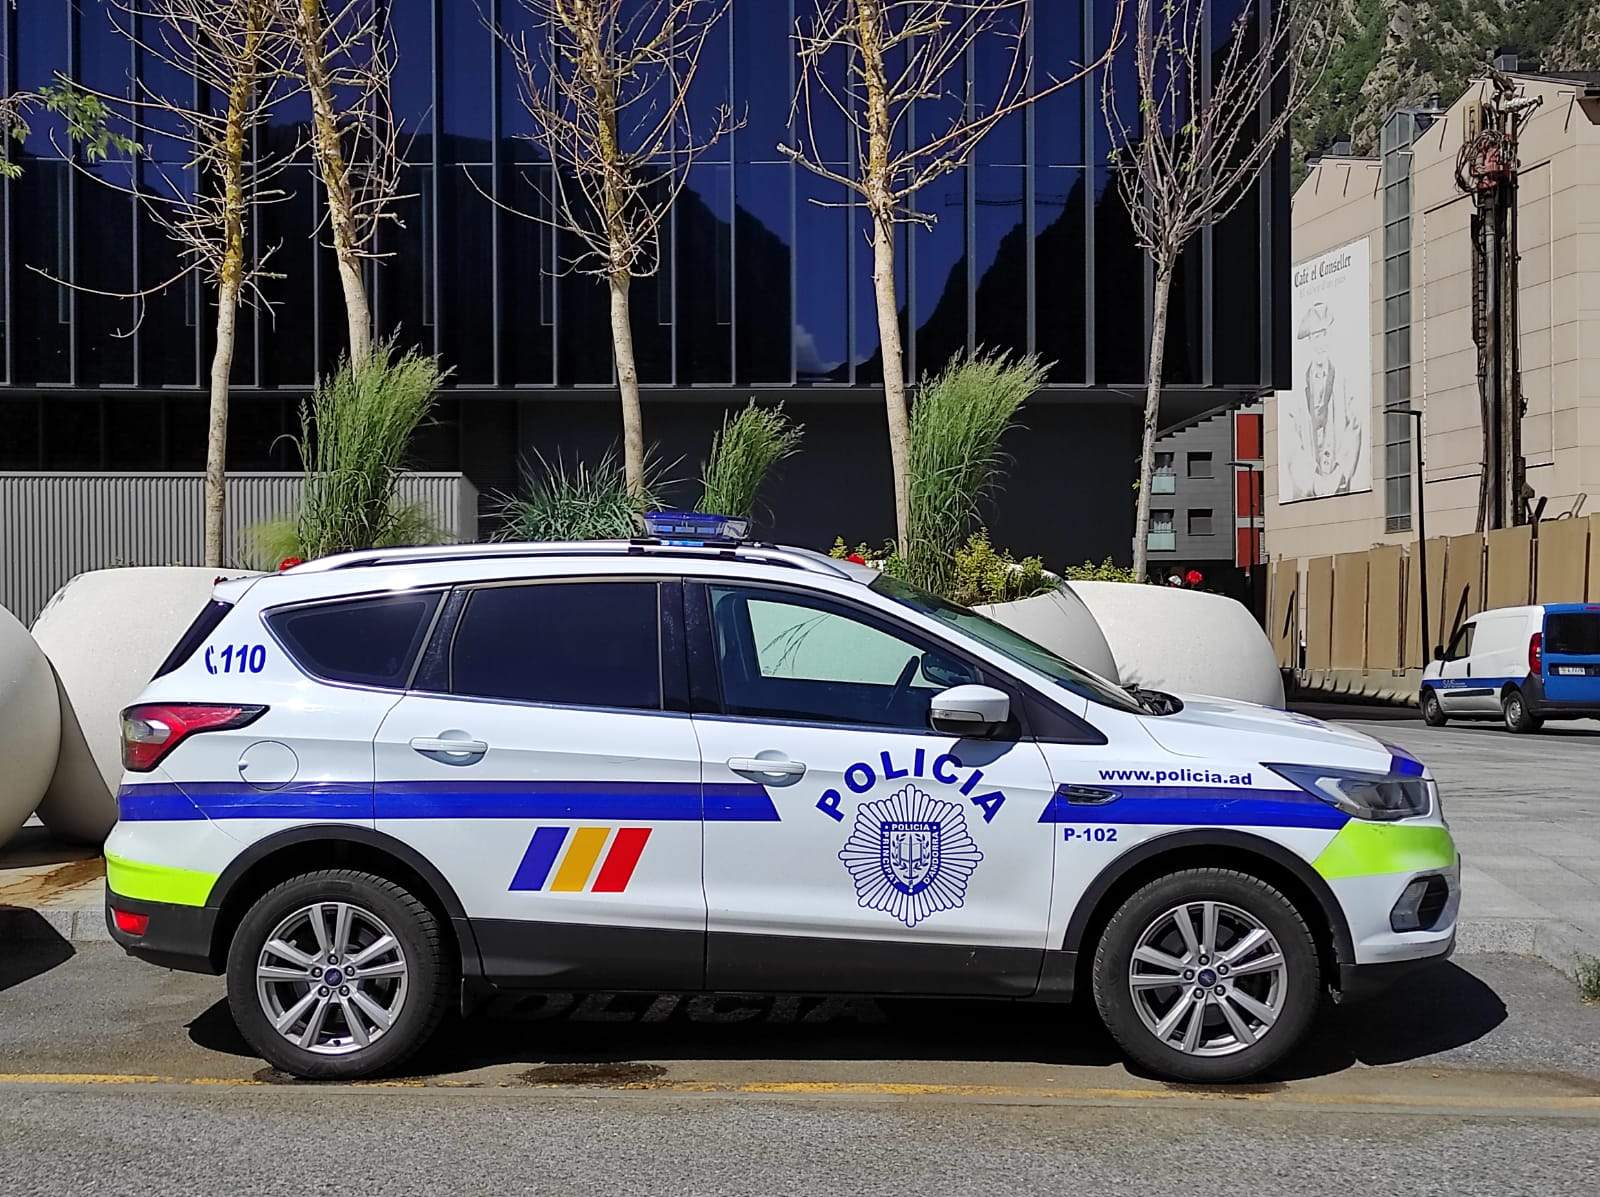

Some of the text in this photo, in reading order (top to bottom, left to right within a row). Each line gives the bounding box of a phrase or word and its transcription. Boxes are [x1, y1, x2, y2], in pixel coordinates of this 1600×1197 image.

[1311, 265, 1316, 280] el
[1319, 253, 1351, 277] Conseller
[221, 644, 266, 673] 110
[815, 748, 1007, 824] POLICIA
[1098, 768, 1253, 786] www.policia.ad
[1063, 828, 1118, 842] P-102
[882, 832, 939, 884] PRINCIPAT D'ANDORRA
[490, 991, 887, 1024] OLICIA
